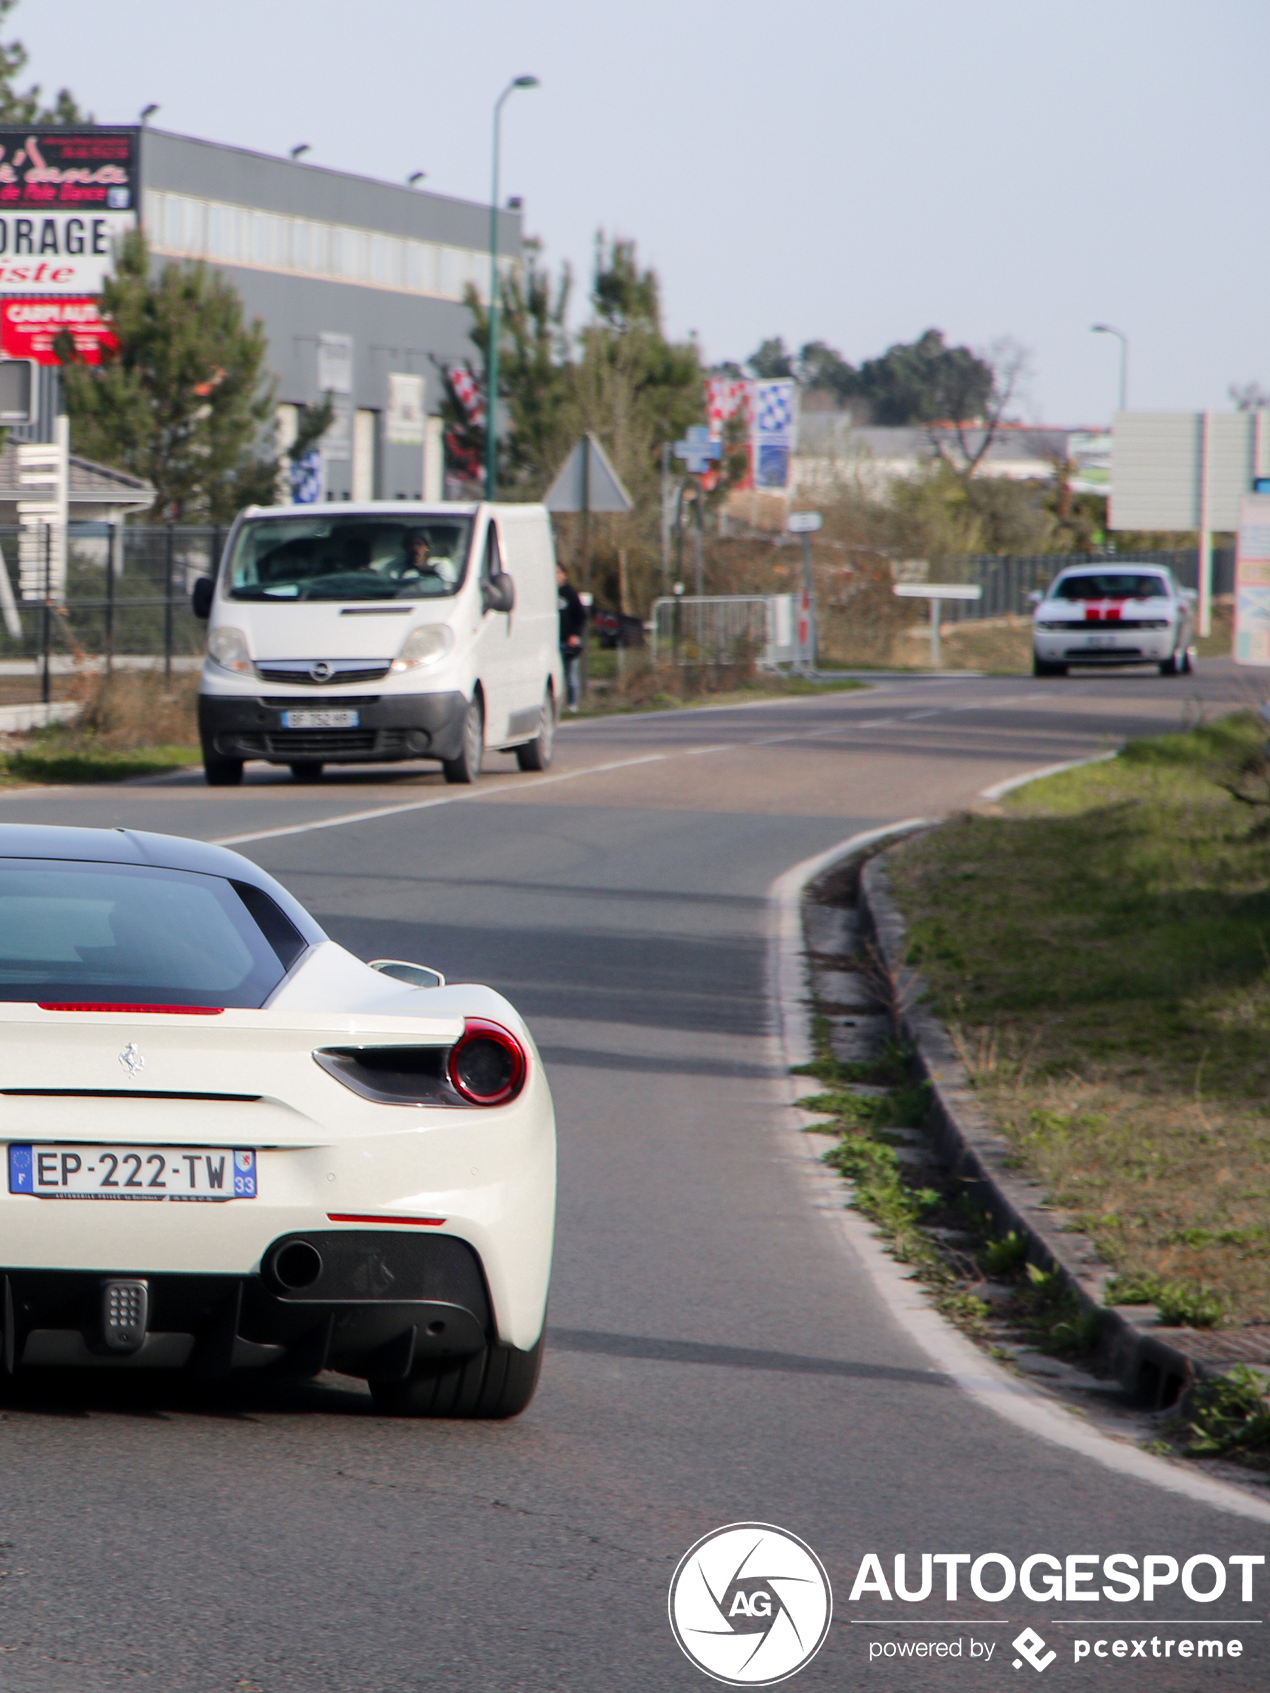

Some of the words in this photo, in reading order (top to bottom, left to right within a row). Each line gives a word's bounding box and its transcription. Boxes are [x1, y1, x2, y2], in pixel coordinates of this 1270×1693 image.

[0, 184, 21, 200] de
[18, 1173, 26, 1185] F
[37, 1153, 226, 1190] EP-222-TW
[234, 1176, 255, 1193] 33
